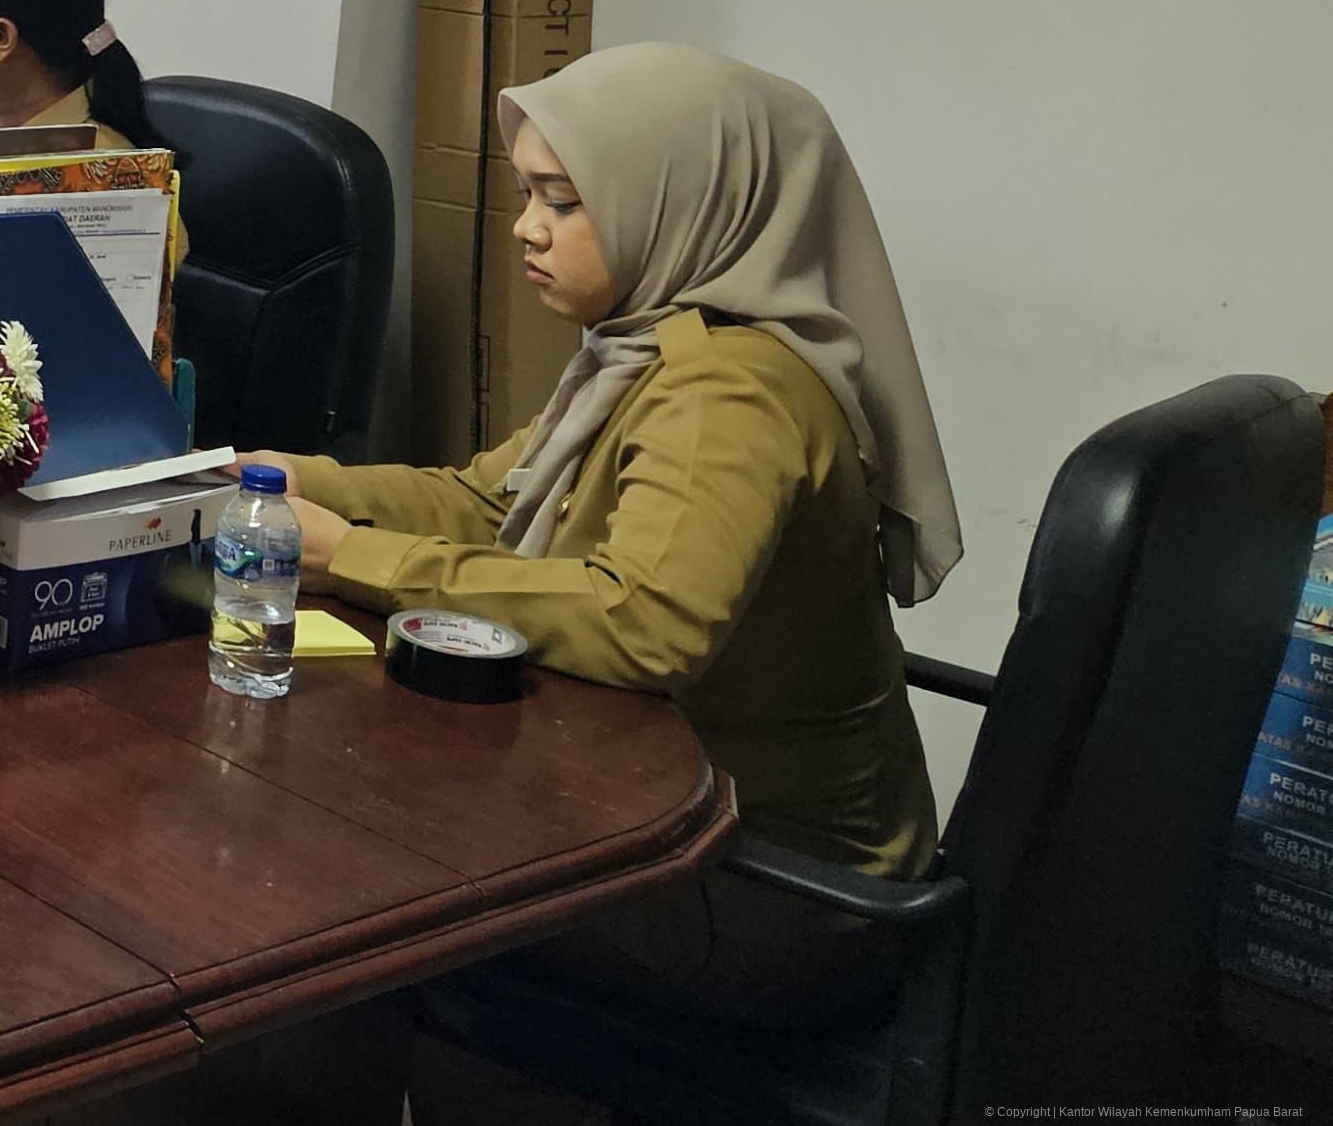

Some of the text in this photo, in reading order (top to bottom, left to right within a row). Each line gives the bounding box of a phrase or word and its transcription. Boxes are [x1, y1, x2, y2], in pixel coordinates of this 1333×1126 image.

[108, 528, 173, 552] PAPERLINE
[34, 578, 74, 611] 90
[29, 613, 105, 643] AMPLOP
[1269, 772, 1333, 805] PERAT
[1273, 790, 1326, 816] NOMOR
